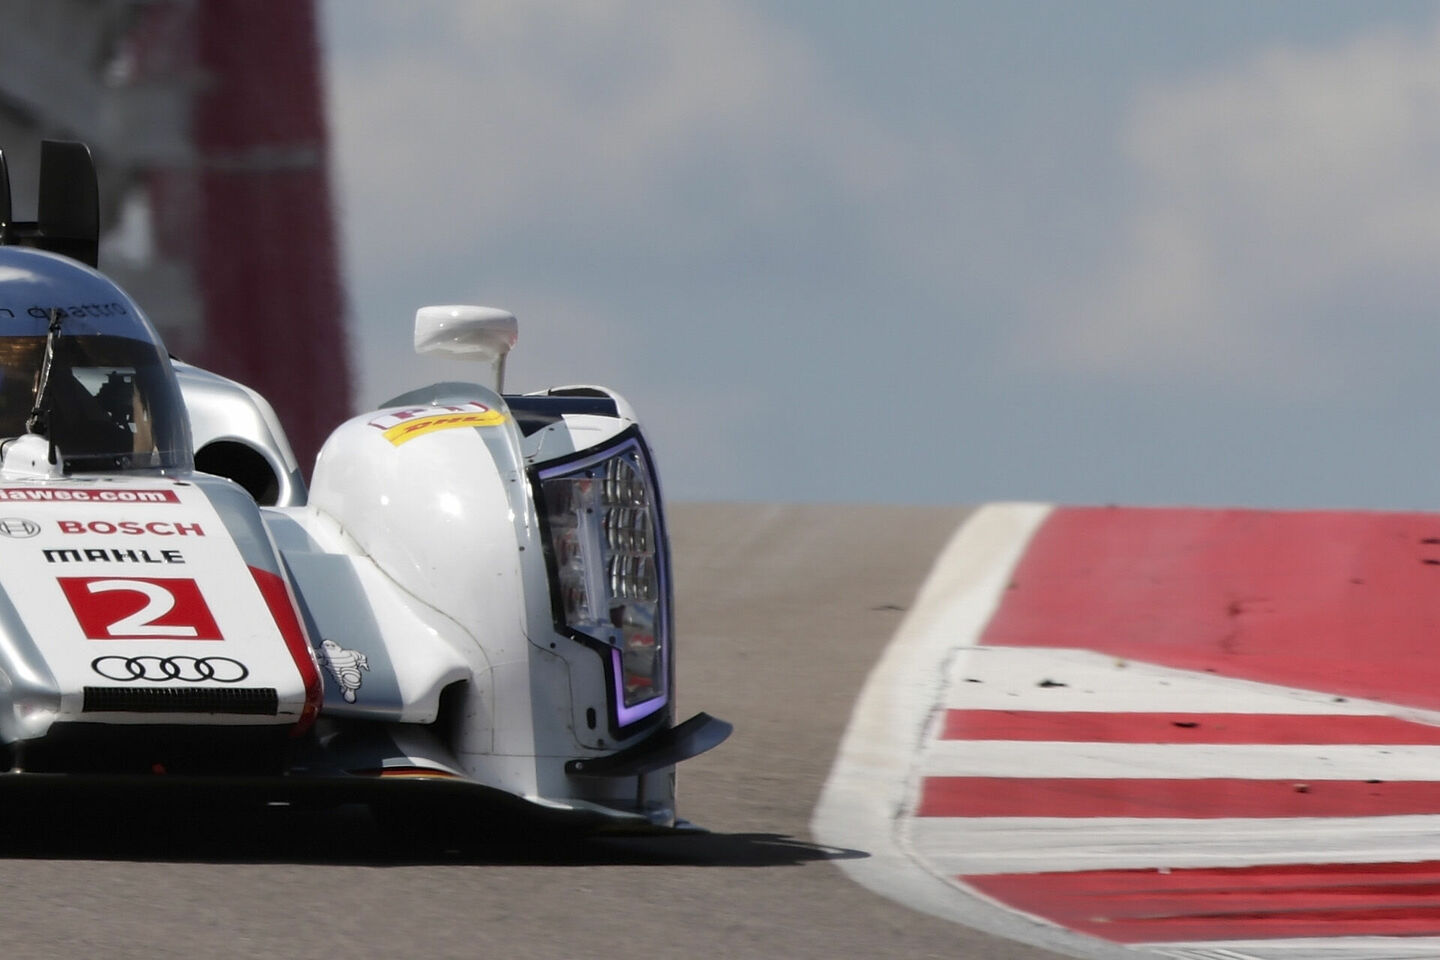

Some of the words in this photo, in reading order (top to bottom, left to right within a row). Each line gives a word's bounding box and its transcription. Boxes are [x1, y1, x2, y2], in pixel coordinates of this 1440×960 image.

[404, 416, 485, 433] DHL
[56, 520, 205, 537] BOSCH
[42, 549, 186, 564] MAHLE
[86, 580, 198, 636] 2
